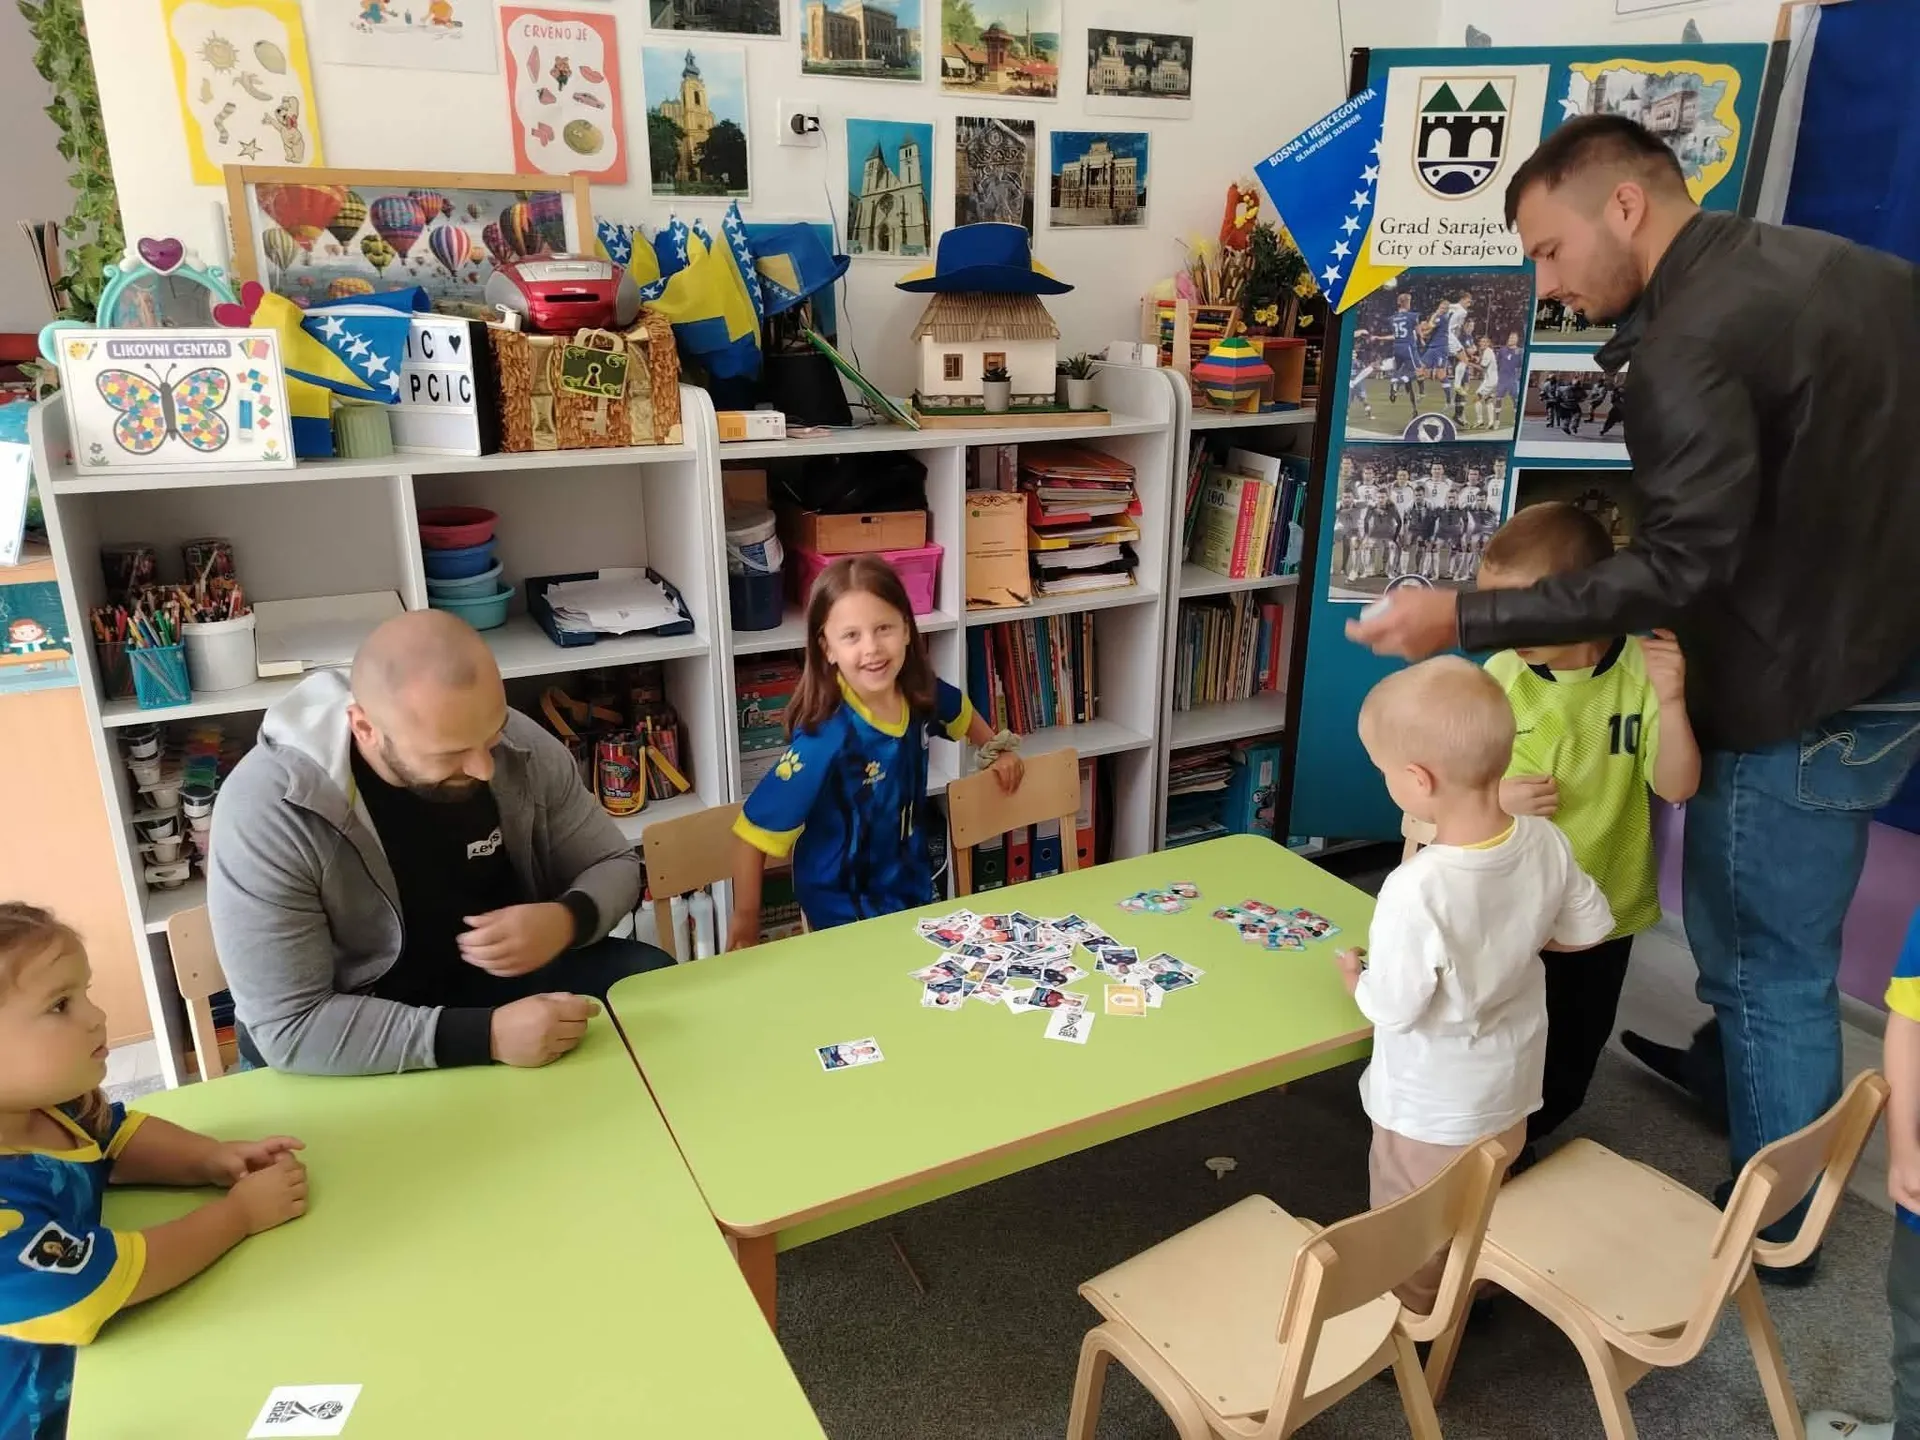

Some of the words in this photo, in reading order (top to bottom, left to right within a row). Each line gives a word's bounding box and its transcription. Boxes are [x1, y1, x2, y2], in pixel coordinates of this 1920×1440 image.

[523, 24, 572, 40] CRVENO
[575, 28, 588, 41] JE
[1268, 141, 1304, 167] BOSNA
[1302, 134, 1309, 144] I
[1308, 87, 1378, 140] HERCEGOVINA
[1331, 113, 1362, 138] SUVENIR
[1380, 216, 1430, 234] Grad
[1377, 239, 1413, 260] City
[1418, 239, 1440, 255] of
[1441, 239, 1518, 260] Sarajevo
[1392, 321, 1408, 339] 15
[112, 343, 170, 357] LIKOVNI
[173, 343, 228, 356] CENTAR
[1608, 712, 1642, 756] 10
[265, 1400, 289, 1424] 2026
